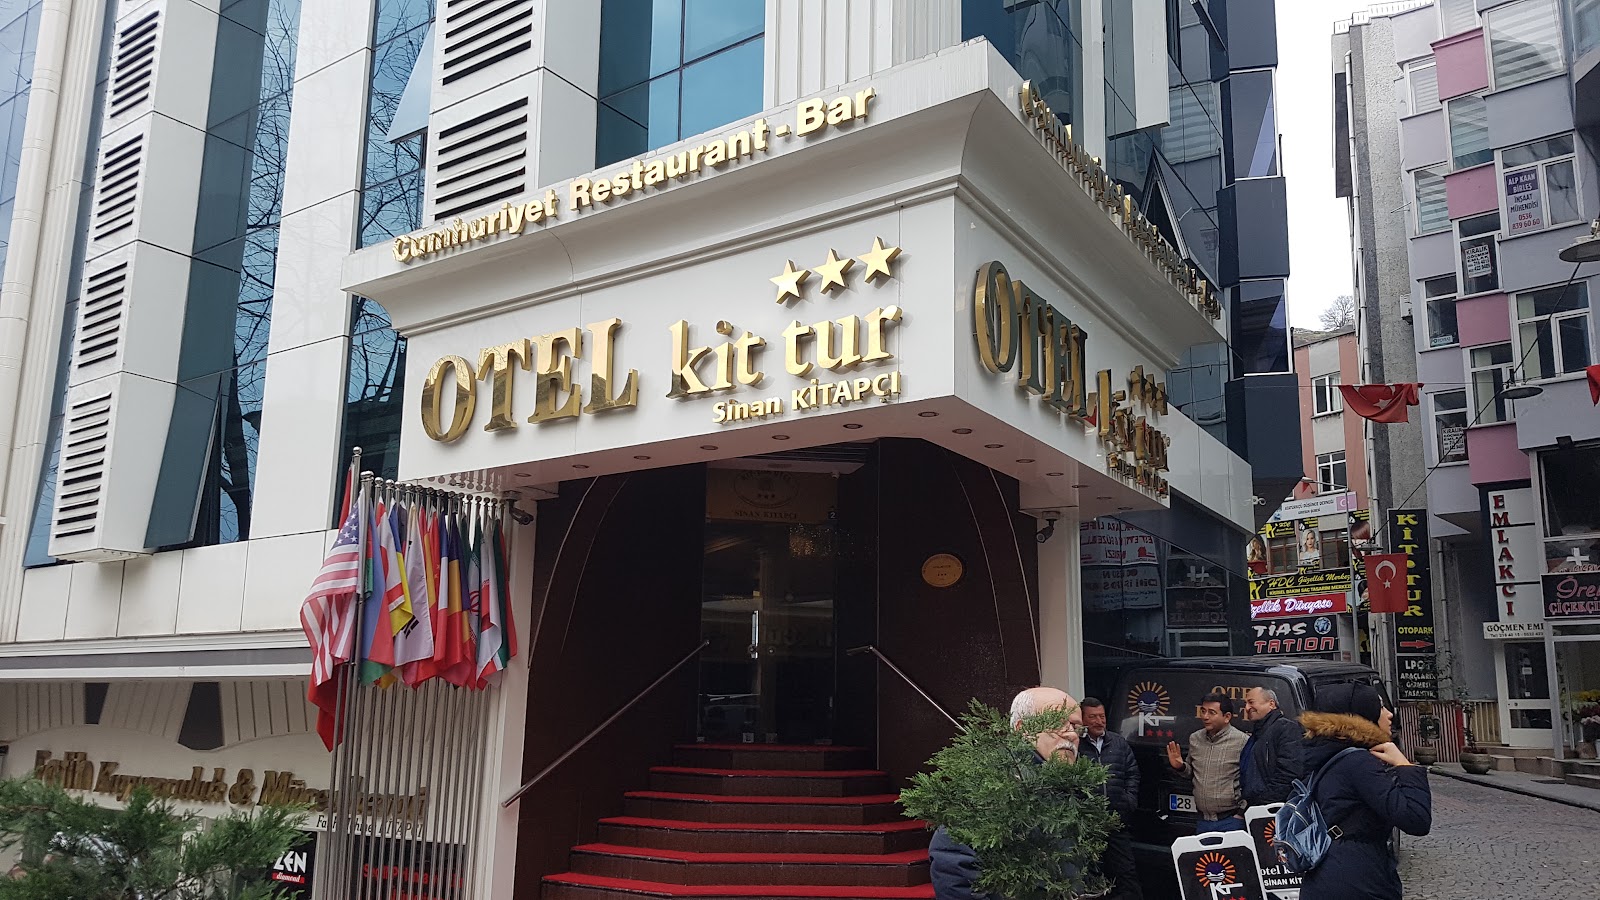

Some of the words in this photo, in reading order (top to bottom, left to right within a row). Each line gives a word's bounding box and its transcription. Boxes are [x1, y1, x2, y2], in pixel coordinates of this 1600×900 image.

[392, 189, 559, 263] Cumhuriyet
[569, 118, 769, 213] Restaurant
[797, 86, 877, 138] Bar
[421, 317, 638, 443] OTEL
[666, 319, 766, 400] kit
[782, 304, 903, 377] tur
[712, 395, 783, 424] Sinan
[791, 370, 902, 411] KİTAPÇI
[1267, 576, 1295, 588] HDC
[1298, 574, 1324, 586] Güzellik
[1398, 626, 1433, 634] OTOPARK
[1487, 624, 1524, 633] GÖÇMEN
[228, 768, 257, 805] &
[1177, 798, 1191, 809] 28
[273, 850, 307, 873] ZEN
[1264, 878, 1288, 887] SİNAN
[1289, 876, 1303, 885] KİT
